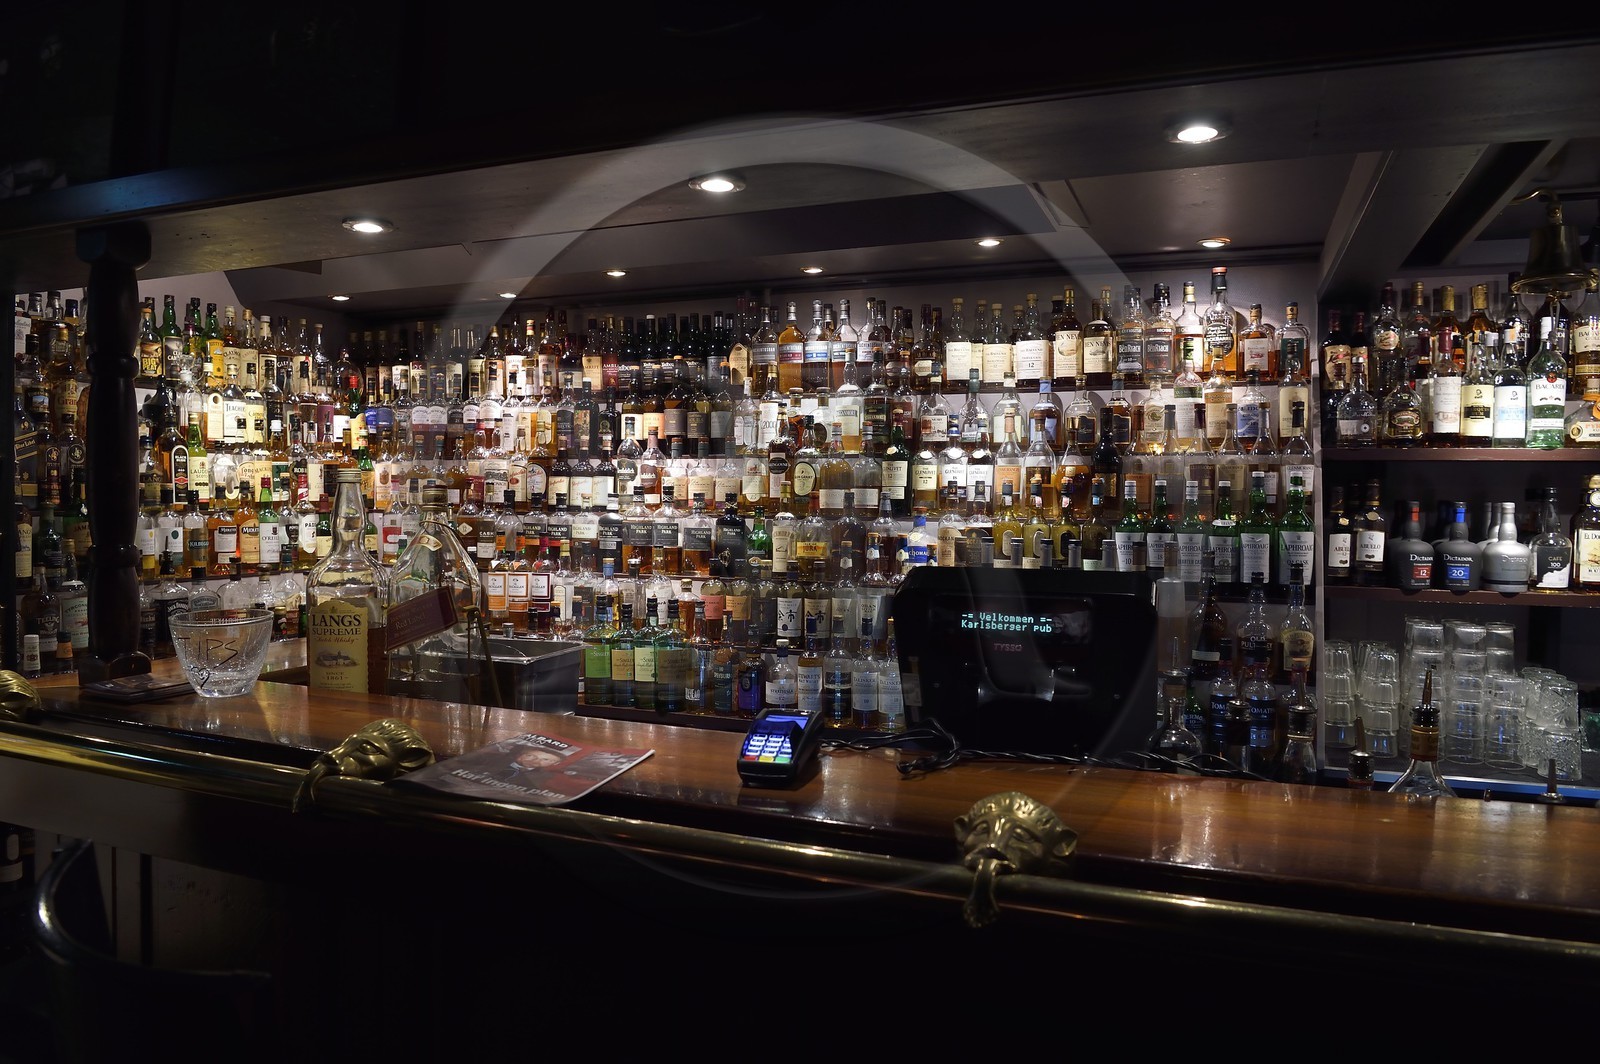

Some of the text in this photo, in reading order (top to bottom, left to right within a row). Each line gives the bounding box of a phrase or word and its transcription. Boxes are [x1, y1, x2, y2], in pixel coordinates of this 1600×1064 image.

[1451, 569, 1465, 577] 20
[312, 614, 361, 627] LANGS
[979, 612, 1034, 624] Velkommen
[961, 619, 1028, 631] Karlsberger
[312, 627, 361, 636] SUPREME
[993, 642, 1022, 652] TYSSO
[177, 638, 239, 669] TIPS
[451, 768, 485, 781] Har
[526, 788, 566, 799] plan
